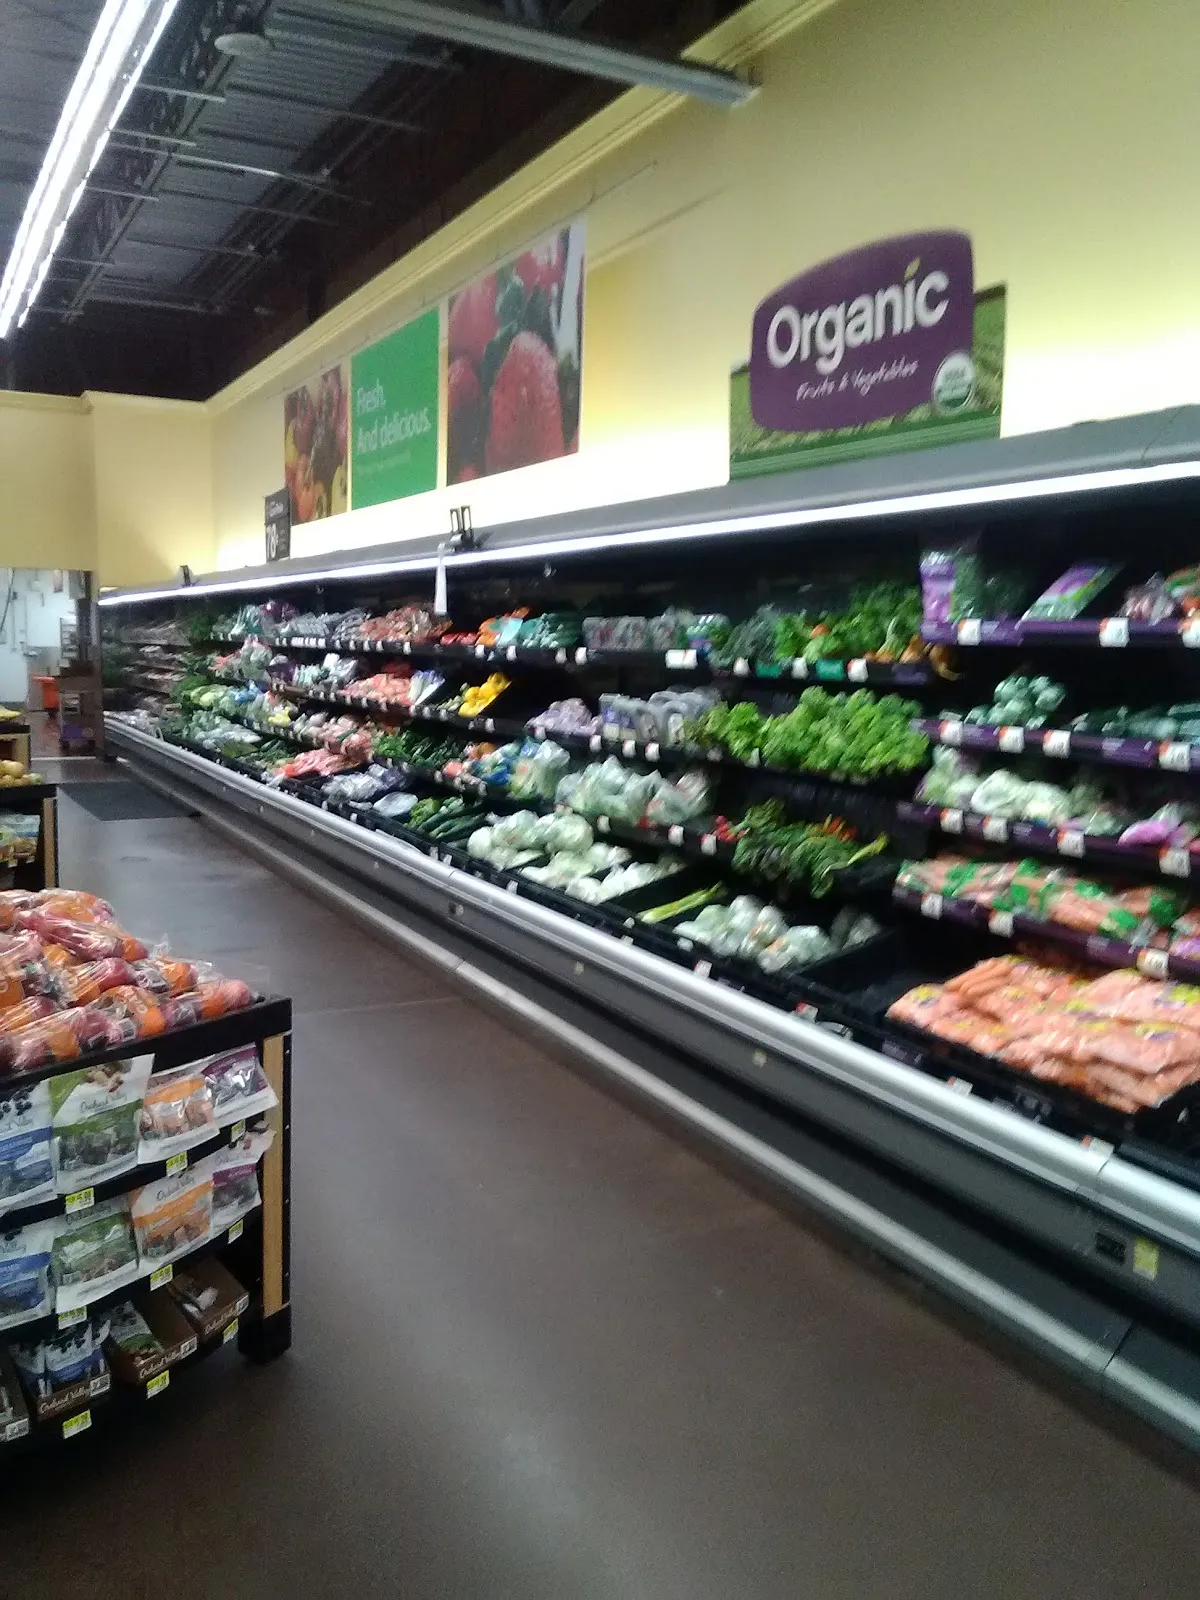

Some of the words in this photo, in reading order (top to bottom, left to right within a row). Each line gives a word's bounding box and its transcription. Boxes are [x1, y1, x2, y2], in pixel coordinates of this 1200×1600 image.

[766, 258, 950, 376] Organic
[851, 356, 919, 397] Vegetables
[356, 419, 379, 455] And
